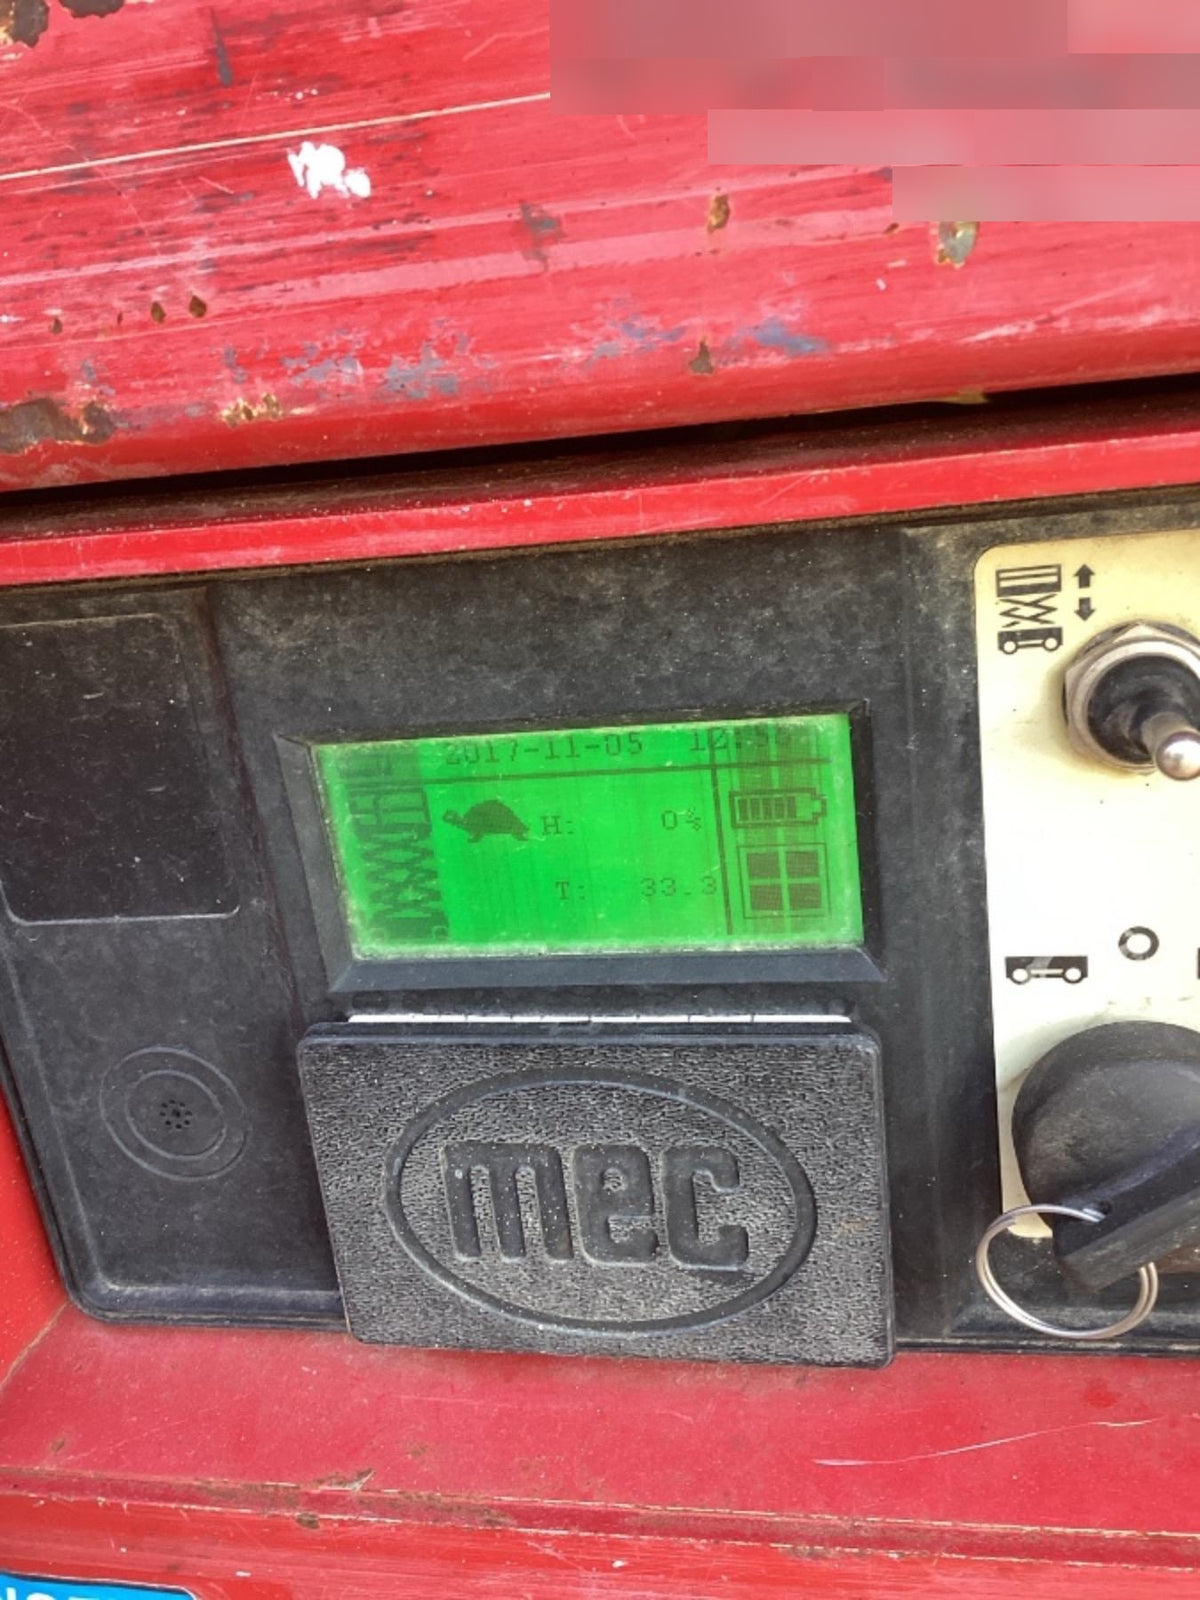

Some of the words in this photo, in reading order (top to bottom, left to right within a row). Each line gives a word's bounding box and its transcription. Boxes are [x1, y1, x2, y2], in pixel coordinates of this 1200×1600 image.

[444, 731, 643, 766] 2017-11-05
[540, 814, 575, 836] H:
[661, 808, 702, 832] 0%
[555, 880, 586, 900] T:
[641, 875, 718, 898] 33.3
